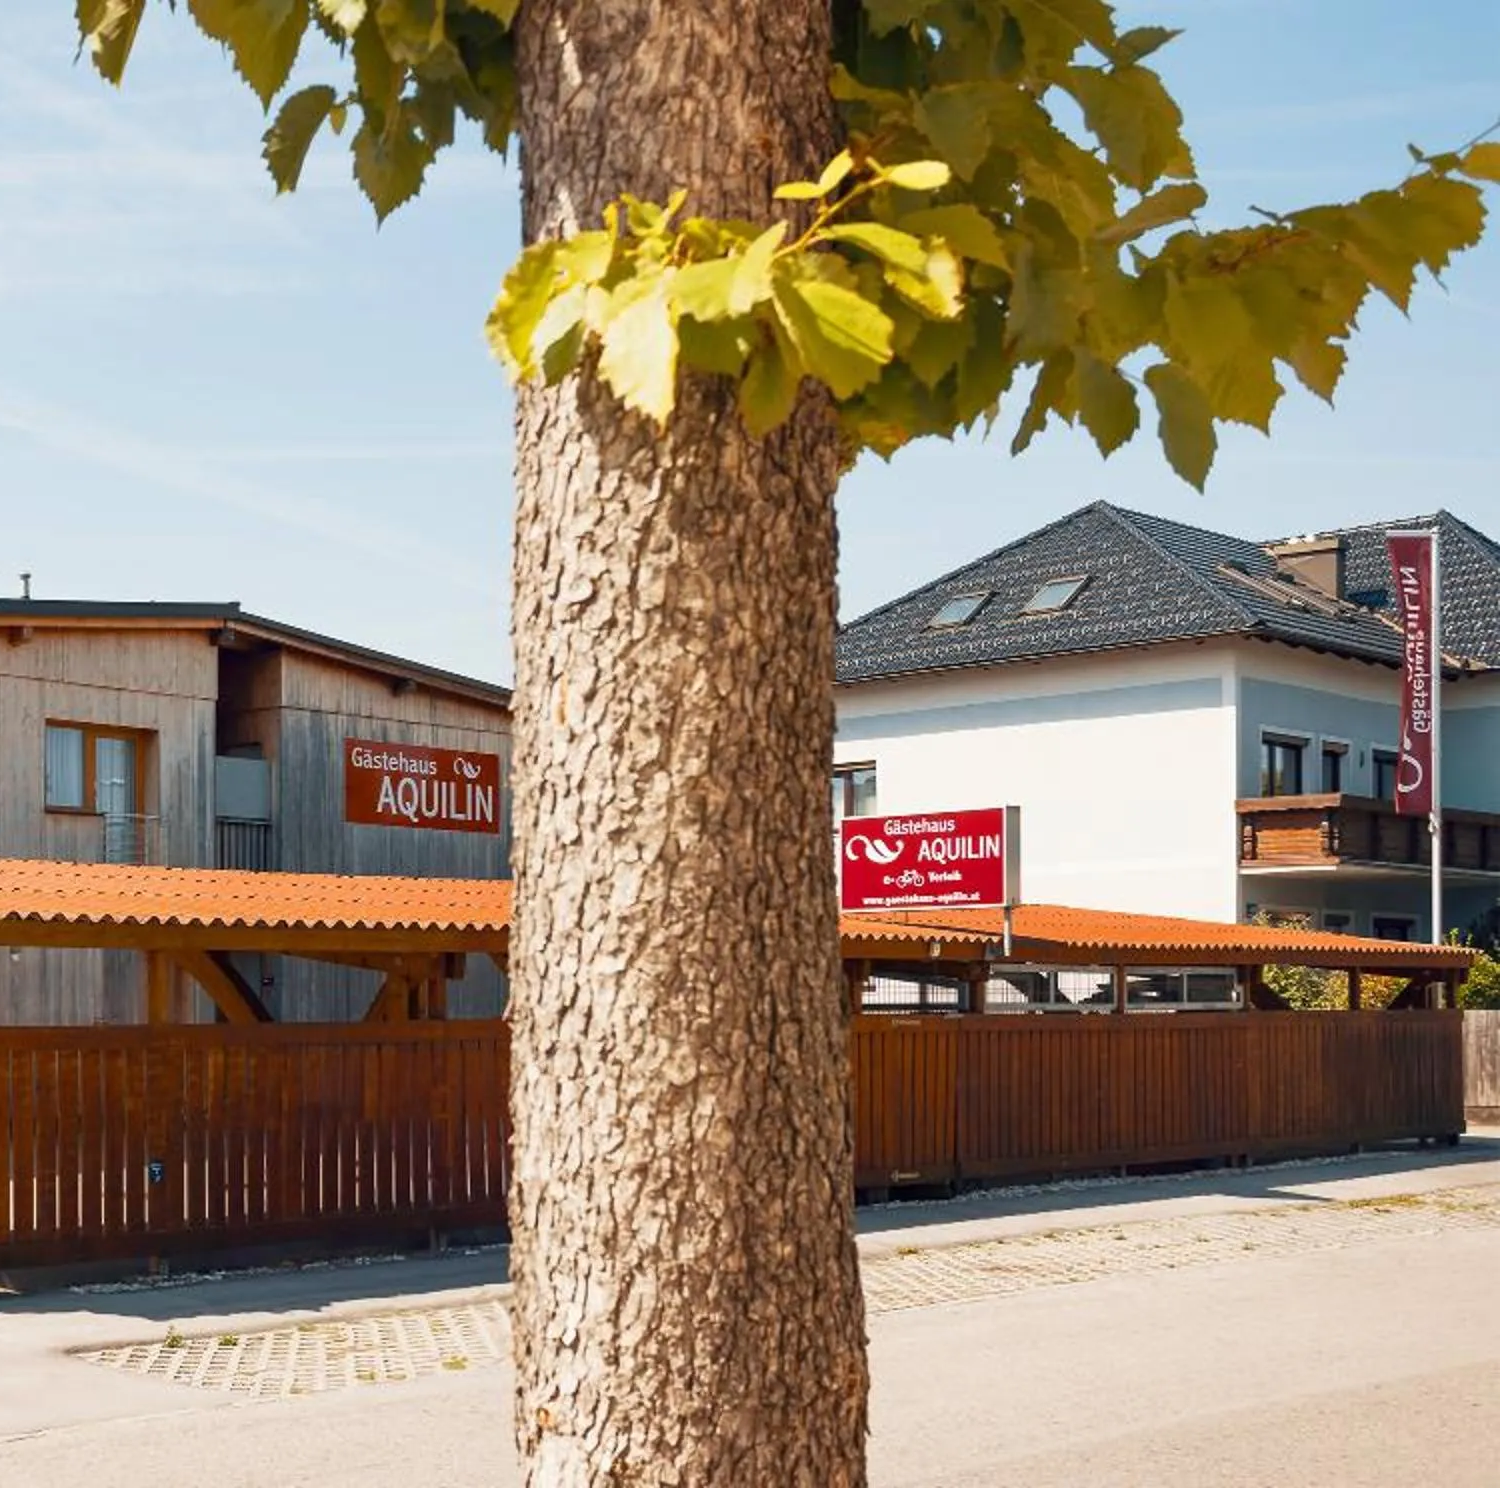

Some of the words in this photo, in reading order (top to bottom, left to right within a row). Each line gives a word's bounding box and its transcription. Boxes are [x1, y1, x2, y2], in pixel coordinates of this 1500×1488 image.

[351, 747, 437, 775] Gästehaus
[377, 776, 493, 823] AQUILIN
[884, 818, 955, 836] Gästehaus
[918, 834, 1000, 864] AQUILIN
